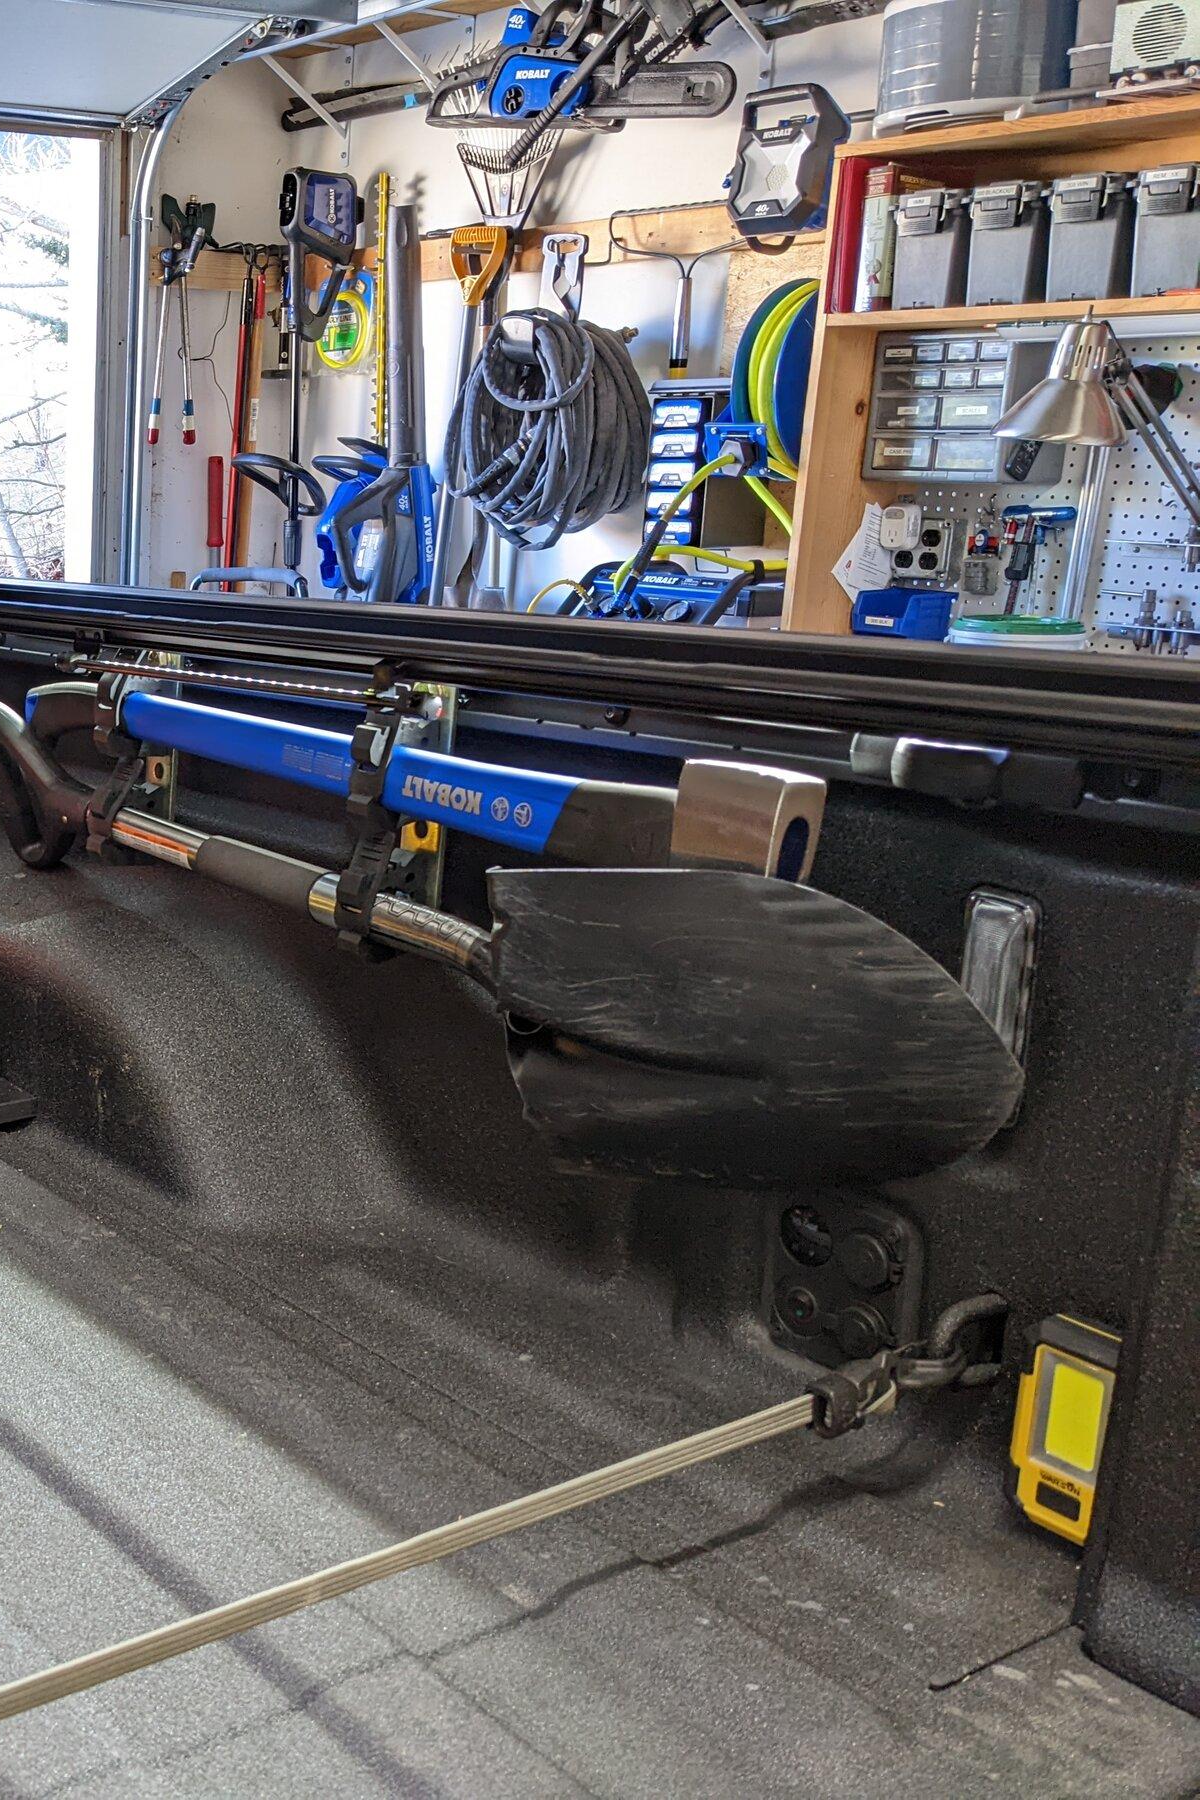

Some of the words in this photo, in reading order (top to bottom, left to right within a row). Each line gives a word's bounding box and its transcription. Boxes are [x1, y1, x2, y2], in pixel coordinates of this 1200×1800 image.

[515, 69, 551, 80] KOBALT
[762, 128, 793, 140] KOBALT
[422, 515, 434, 563] KOBALT
[642, 575, 679, 585] KOBALT
[402, 774, 483, 815] KOBALT
